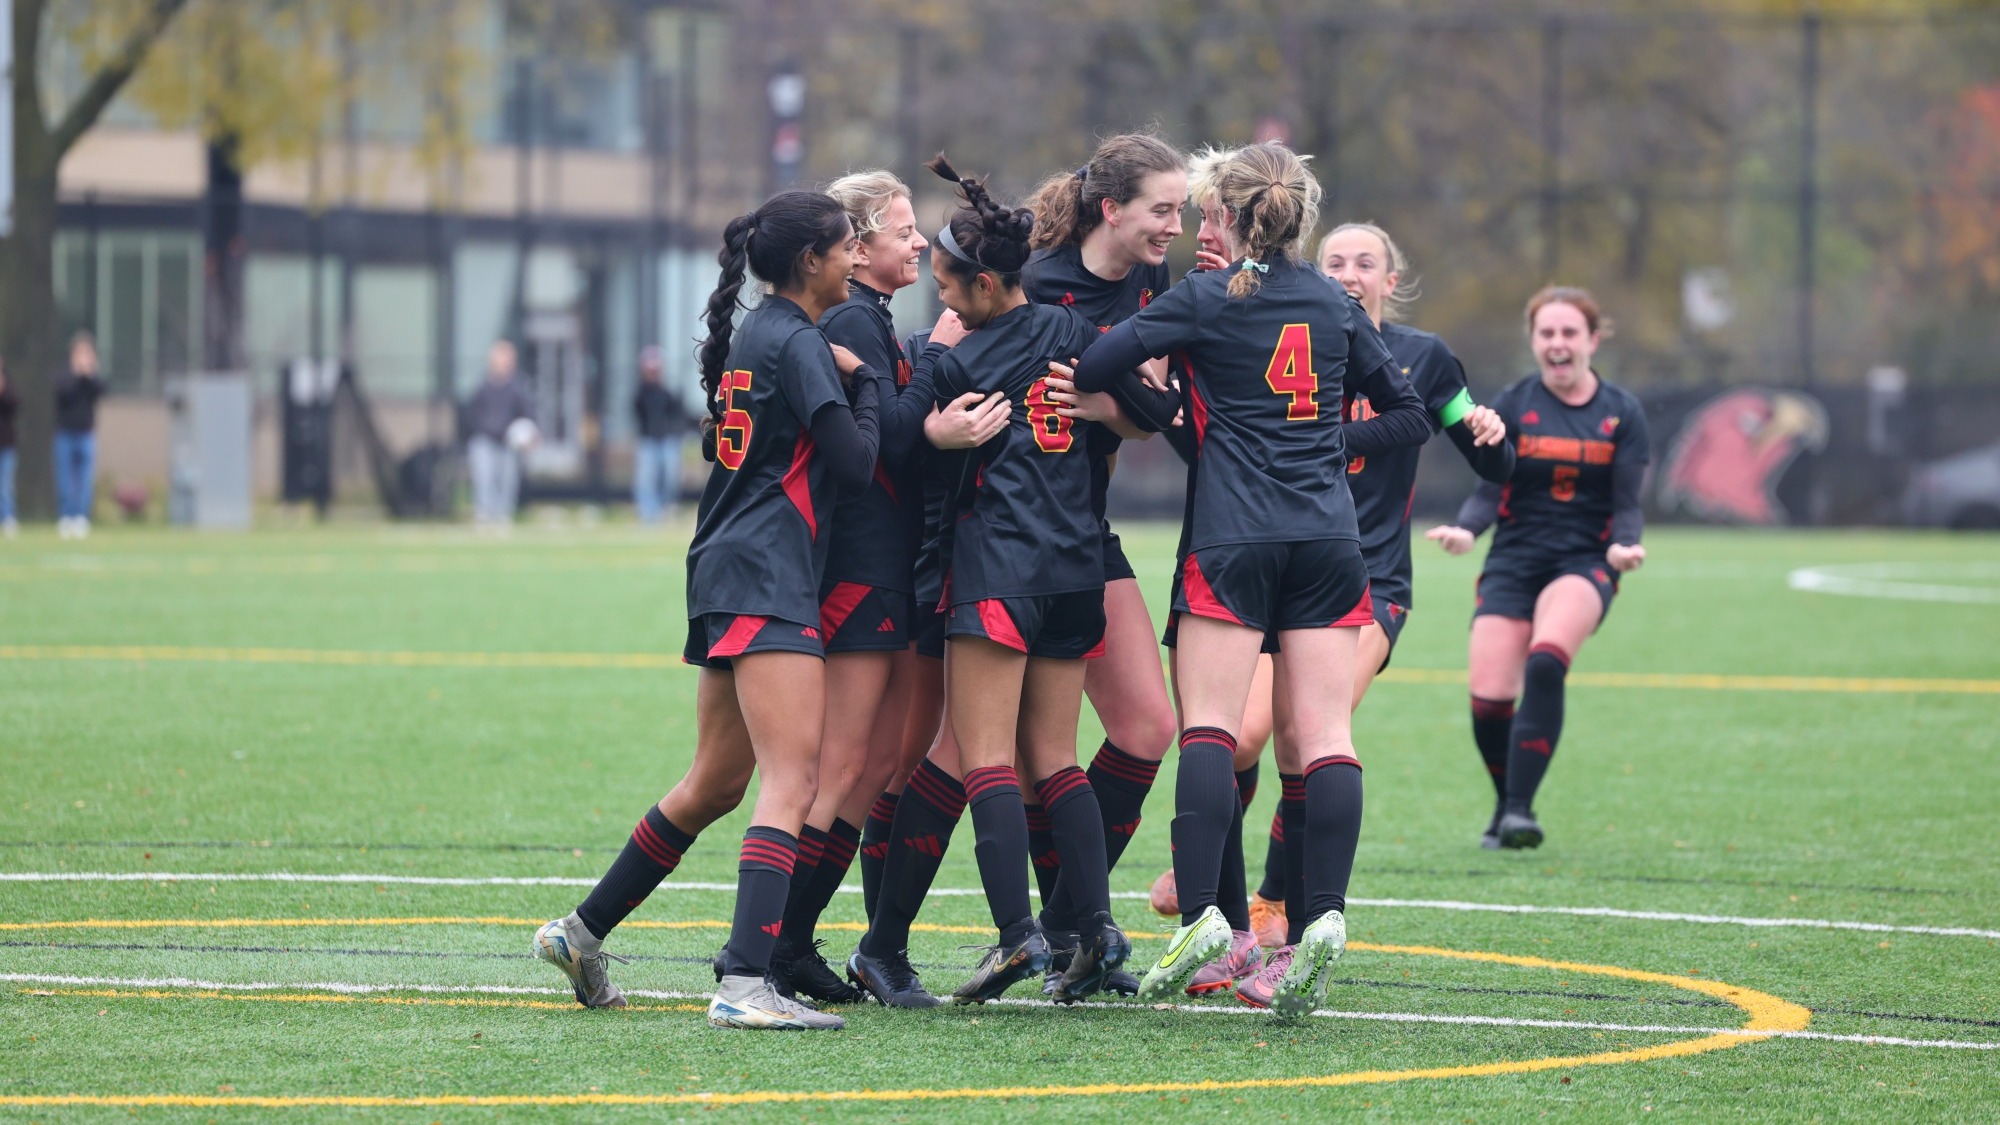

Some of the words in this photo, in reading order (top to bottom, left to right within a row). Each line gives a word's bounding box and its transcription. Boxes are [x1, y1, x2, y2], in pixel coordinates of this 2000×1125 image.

[1265, 323, 1319, 421] 4
[1550, 465, 1580, 502] 5
[1300, 965, 1321, 994] TIEMPO
